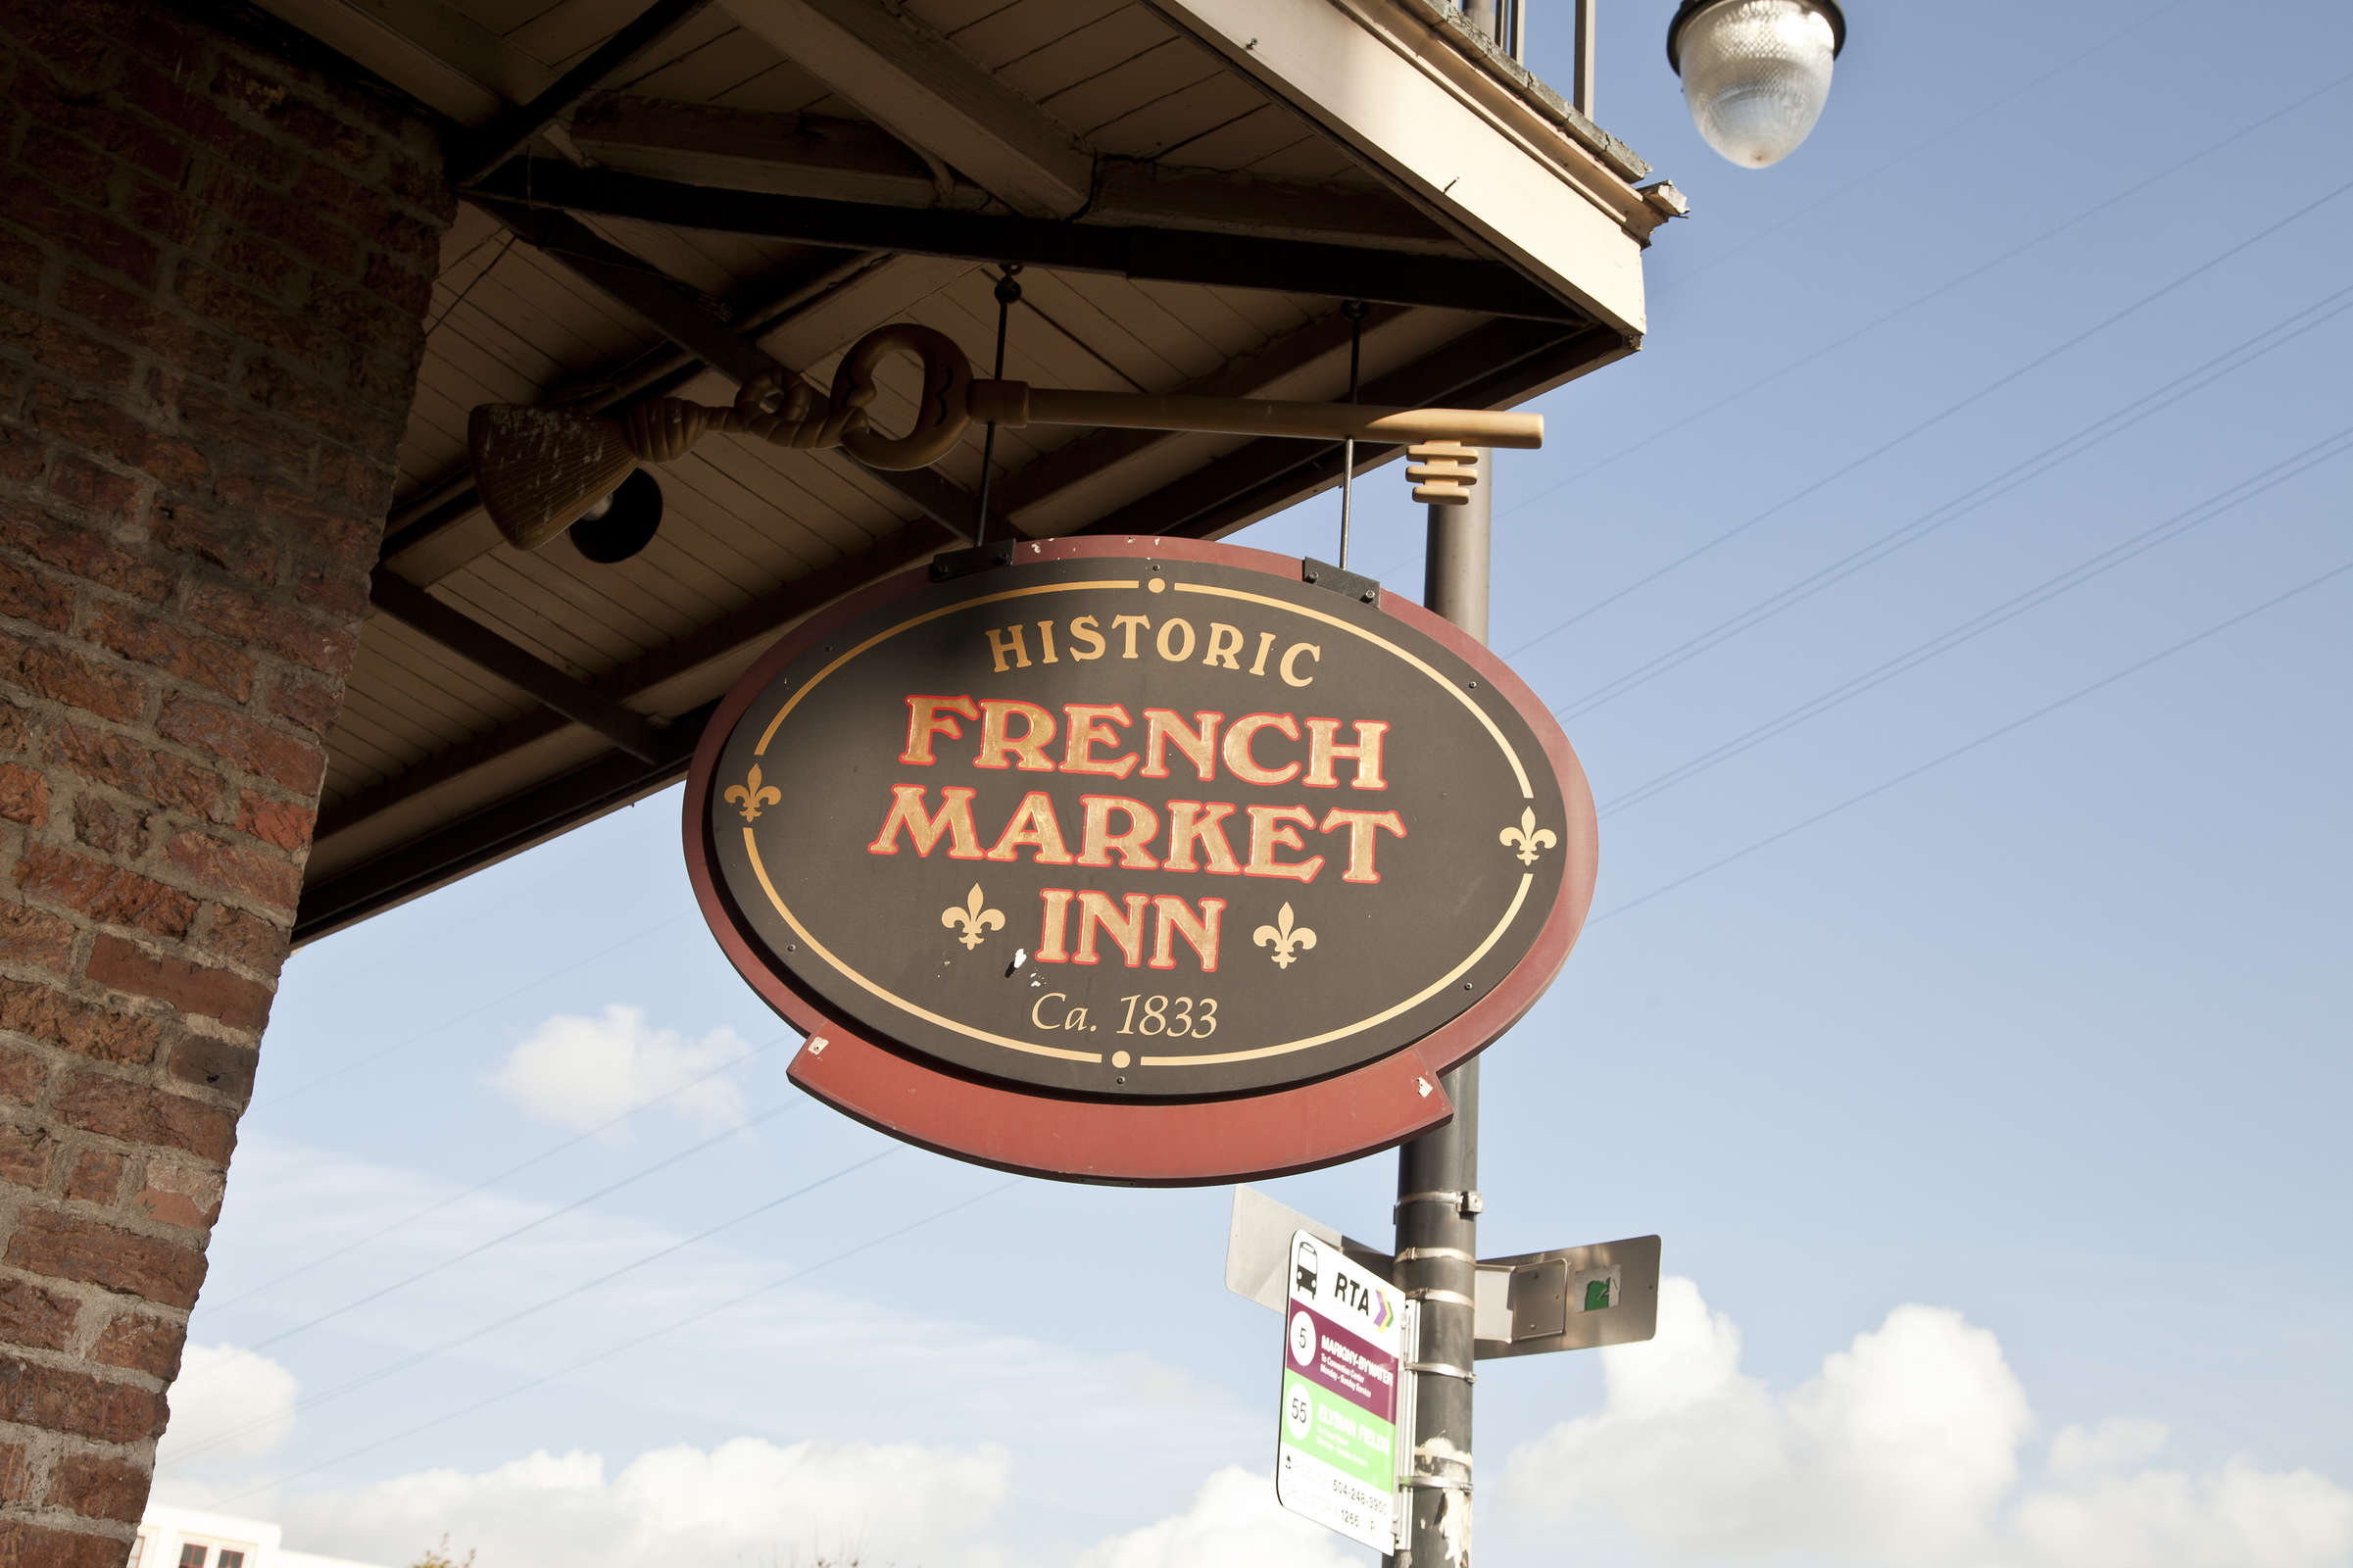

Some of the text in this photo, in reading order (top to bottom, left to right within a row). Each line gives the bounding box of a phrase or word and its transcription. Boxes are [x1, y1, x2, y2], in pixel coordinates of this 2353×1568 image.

[985, 613, 1321, 688] HISTORIC
[898, 695, 1391, 791] FRENCH
[867, 783, 1407, 885] MARKET
[1034, 888, 1227, 972] INN
[1030, 992, 1219, 1040] Ca. 1833
[1334, 1272, 1370, 1316] RTA
[1299, 1327, 1307, 1348] 5
[1292, 1397, 1307, 1424] 55
